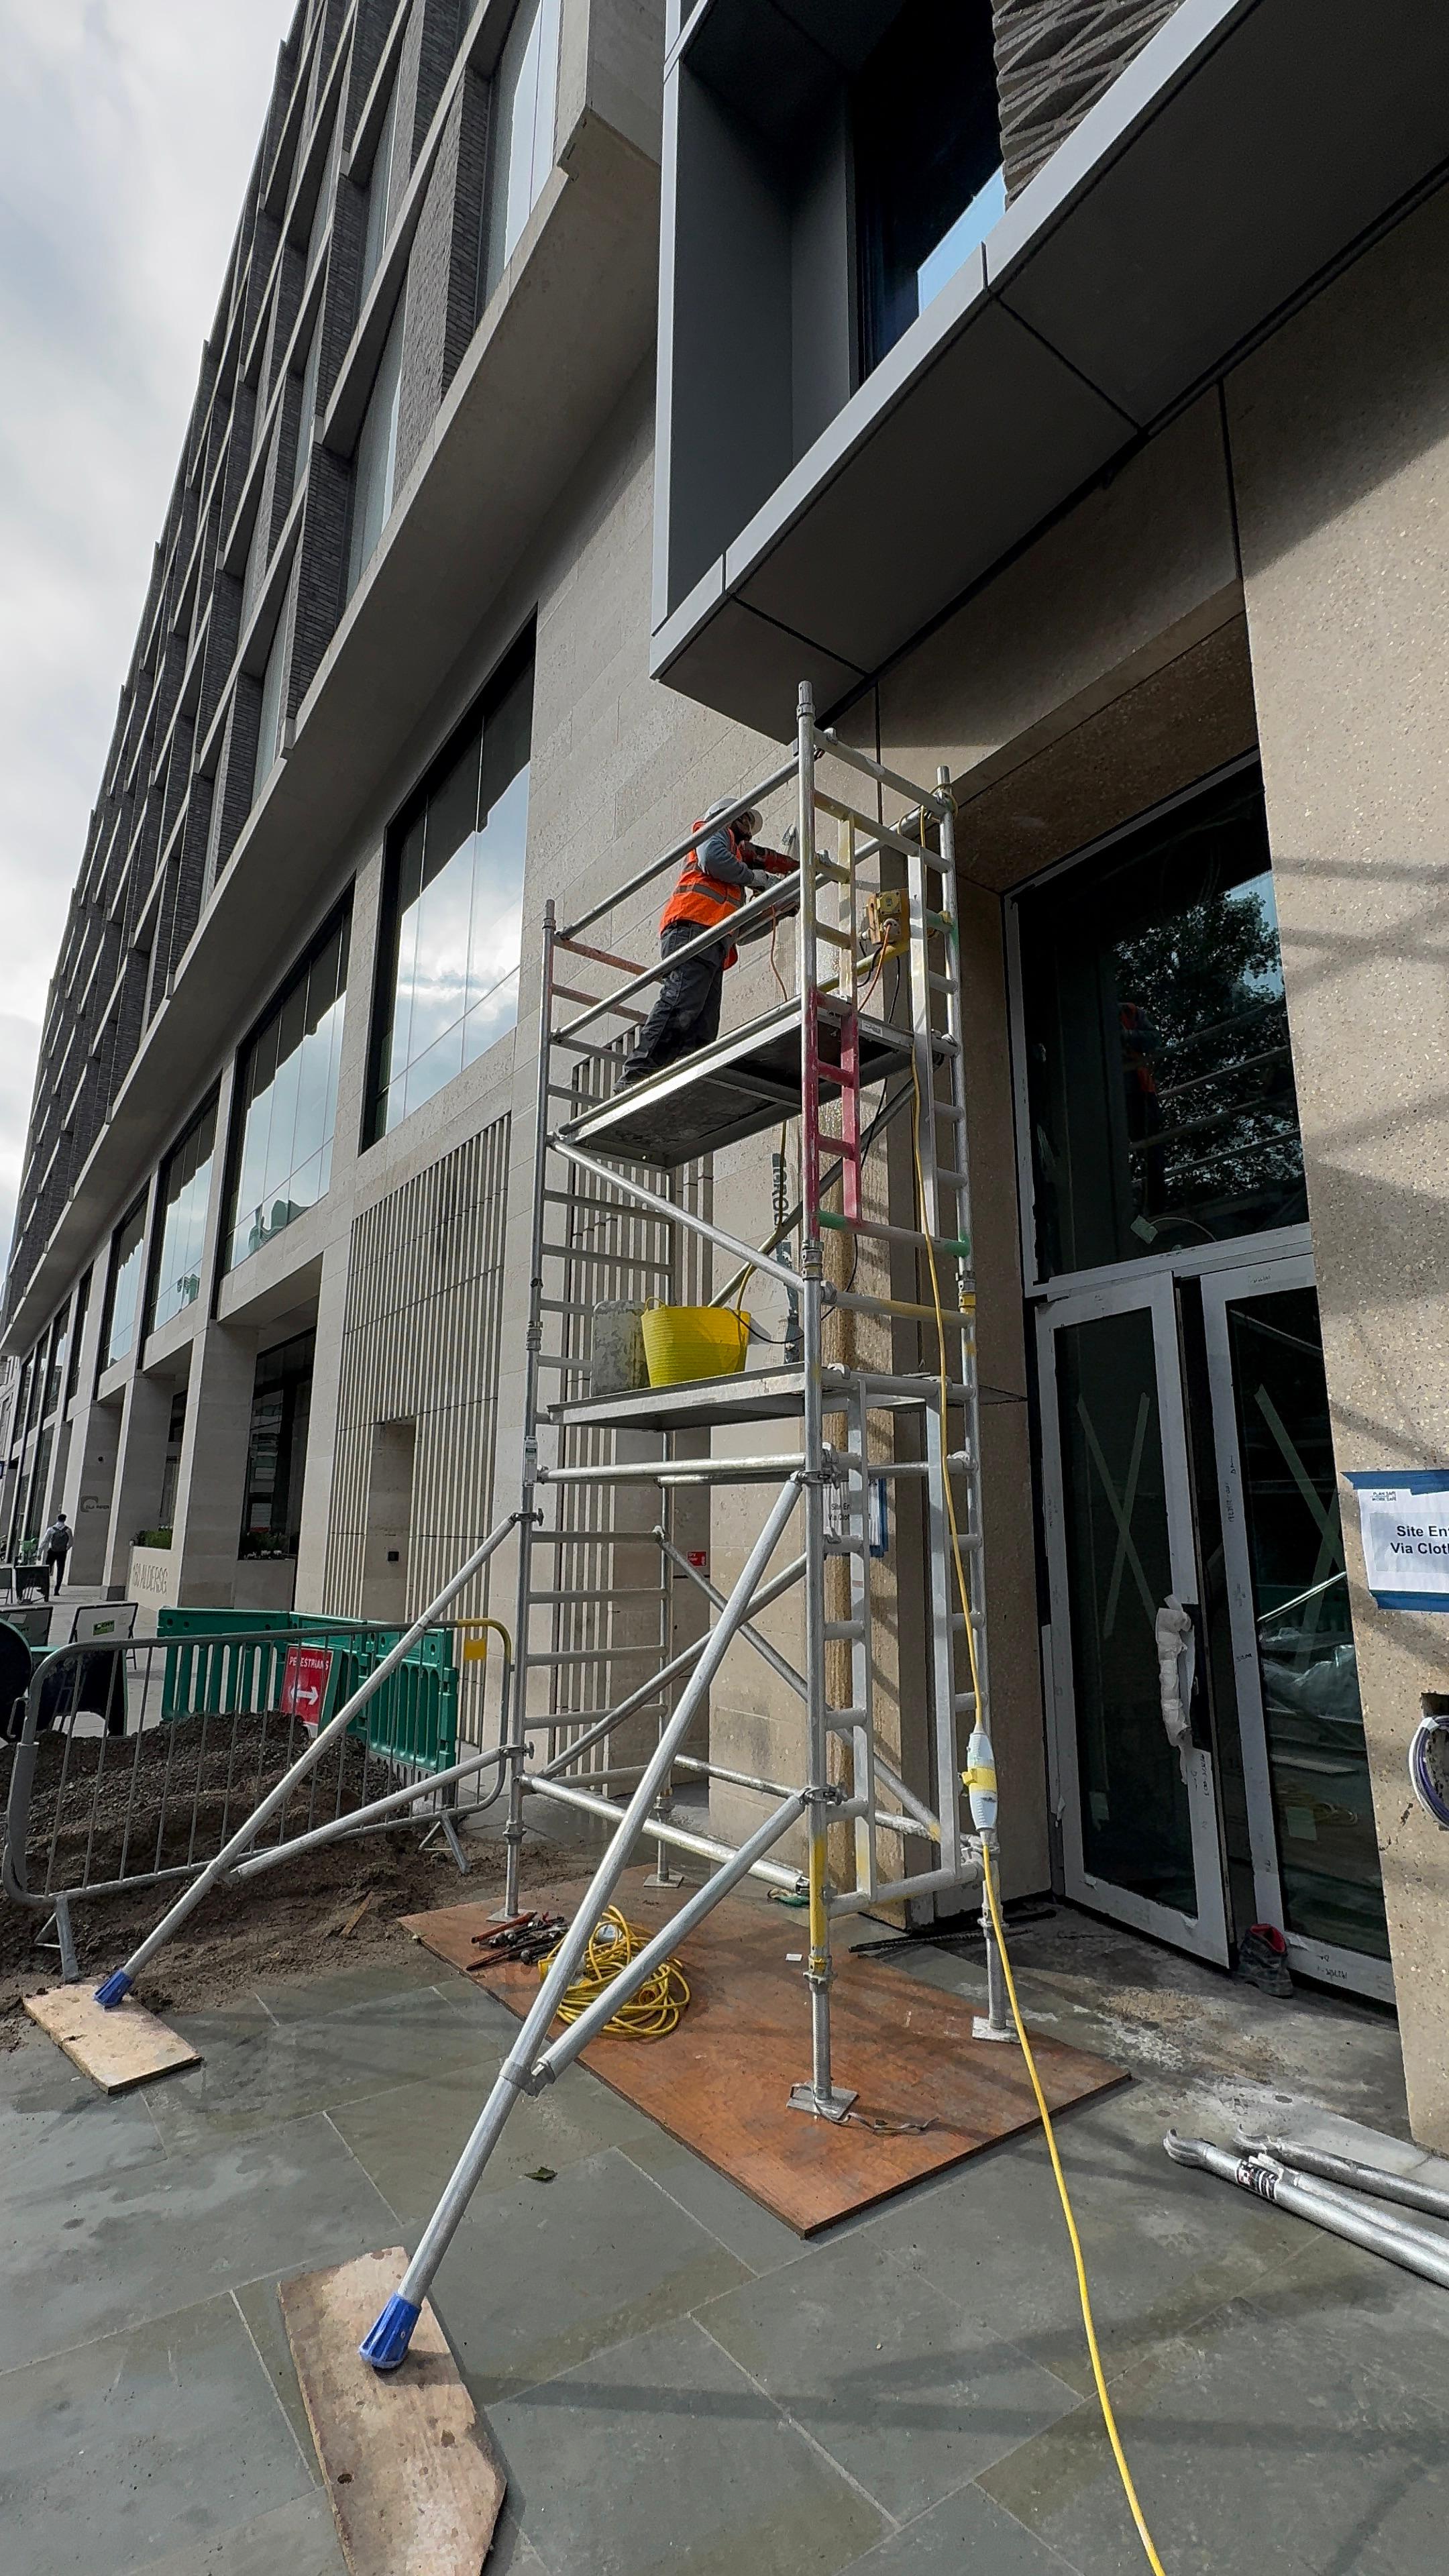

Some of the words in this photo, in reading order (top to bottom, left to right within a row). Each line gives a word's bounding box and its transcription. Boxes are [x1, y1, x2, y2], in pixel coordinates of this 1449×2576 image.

[1397, 1525, 1424, 1537] Site
[1428, 1525, 1449, 1537] En
[1391, 1542, 1413, 1554] Via
[1417, 1542, 1449, 1554] Clot
[289, 1656, 329, 1670] PEESTRIANS
